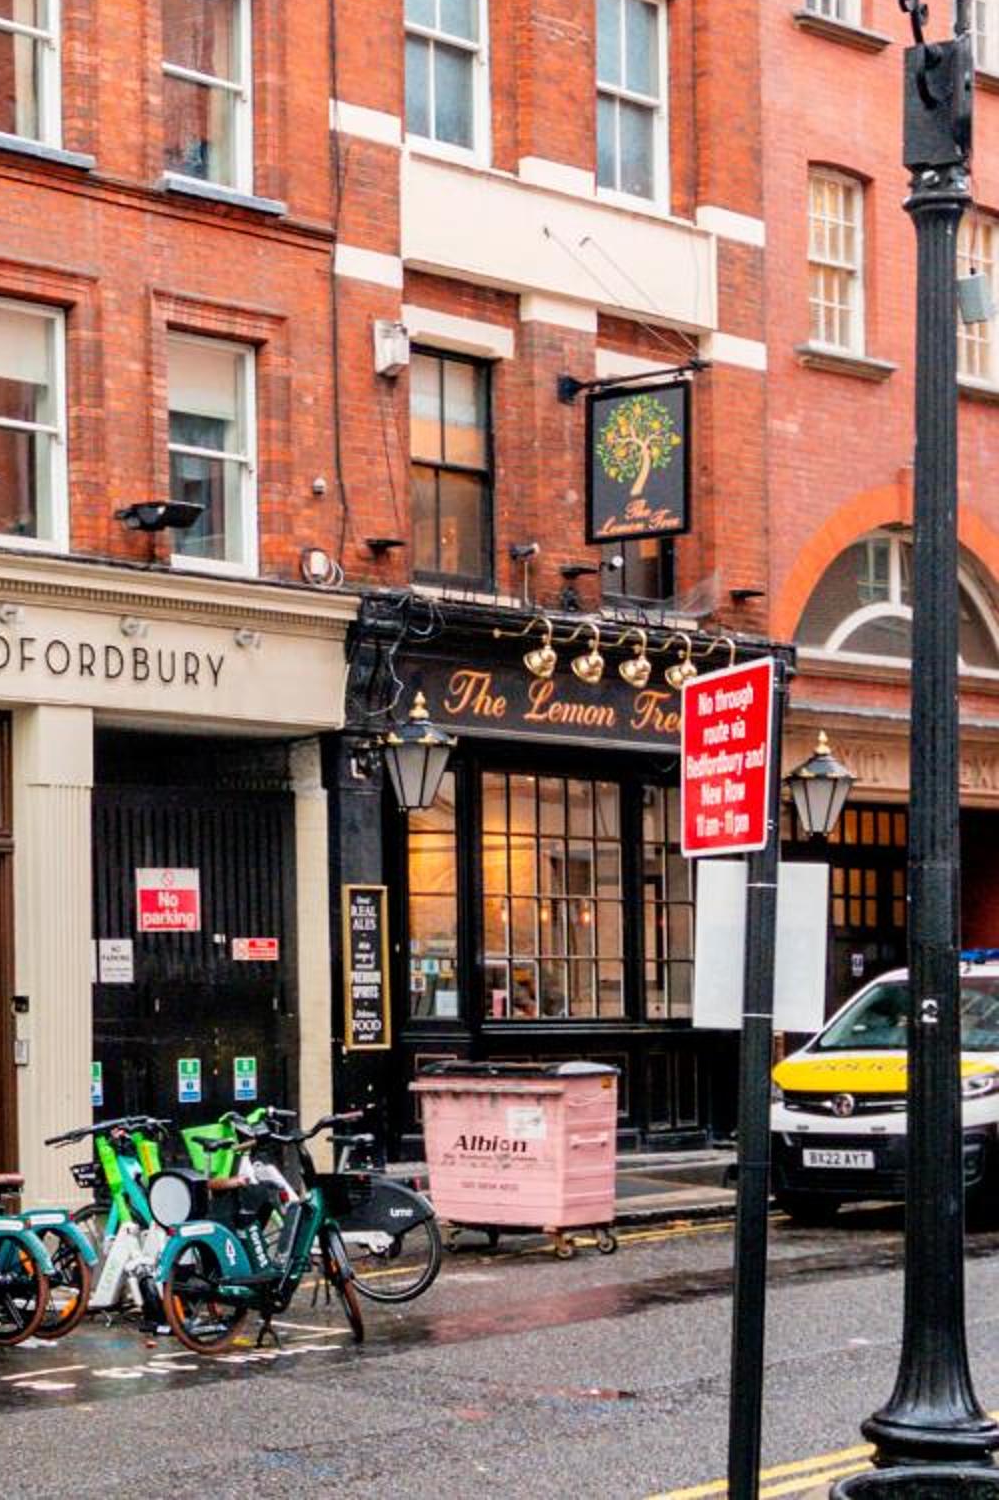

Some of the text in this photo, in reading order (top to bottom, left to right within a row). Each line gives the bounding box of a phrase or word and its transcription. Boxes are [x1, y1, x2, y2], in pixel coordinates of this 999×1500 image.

[443, 669, 506, 718] The
[523, 679, 616, 728] Lemon
[697, 681, 754, 717] No through
[702, 715, 746, 746] route via
[686, 742, 766, 781] Bedfordbury and
[701, 778, 746, 806] New Row
[157, 892, 179, 908] No
[142, 910, 195, 926] parking
[352, 1020, 382, 1032] FOOD
[454, 1135, 527, 1153] Albion
